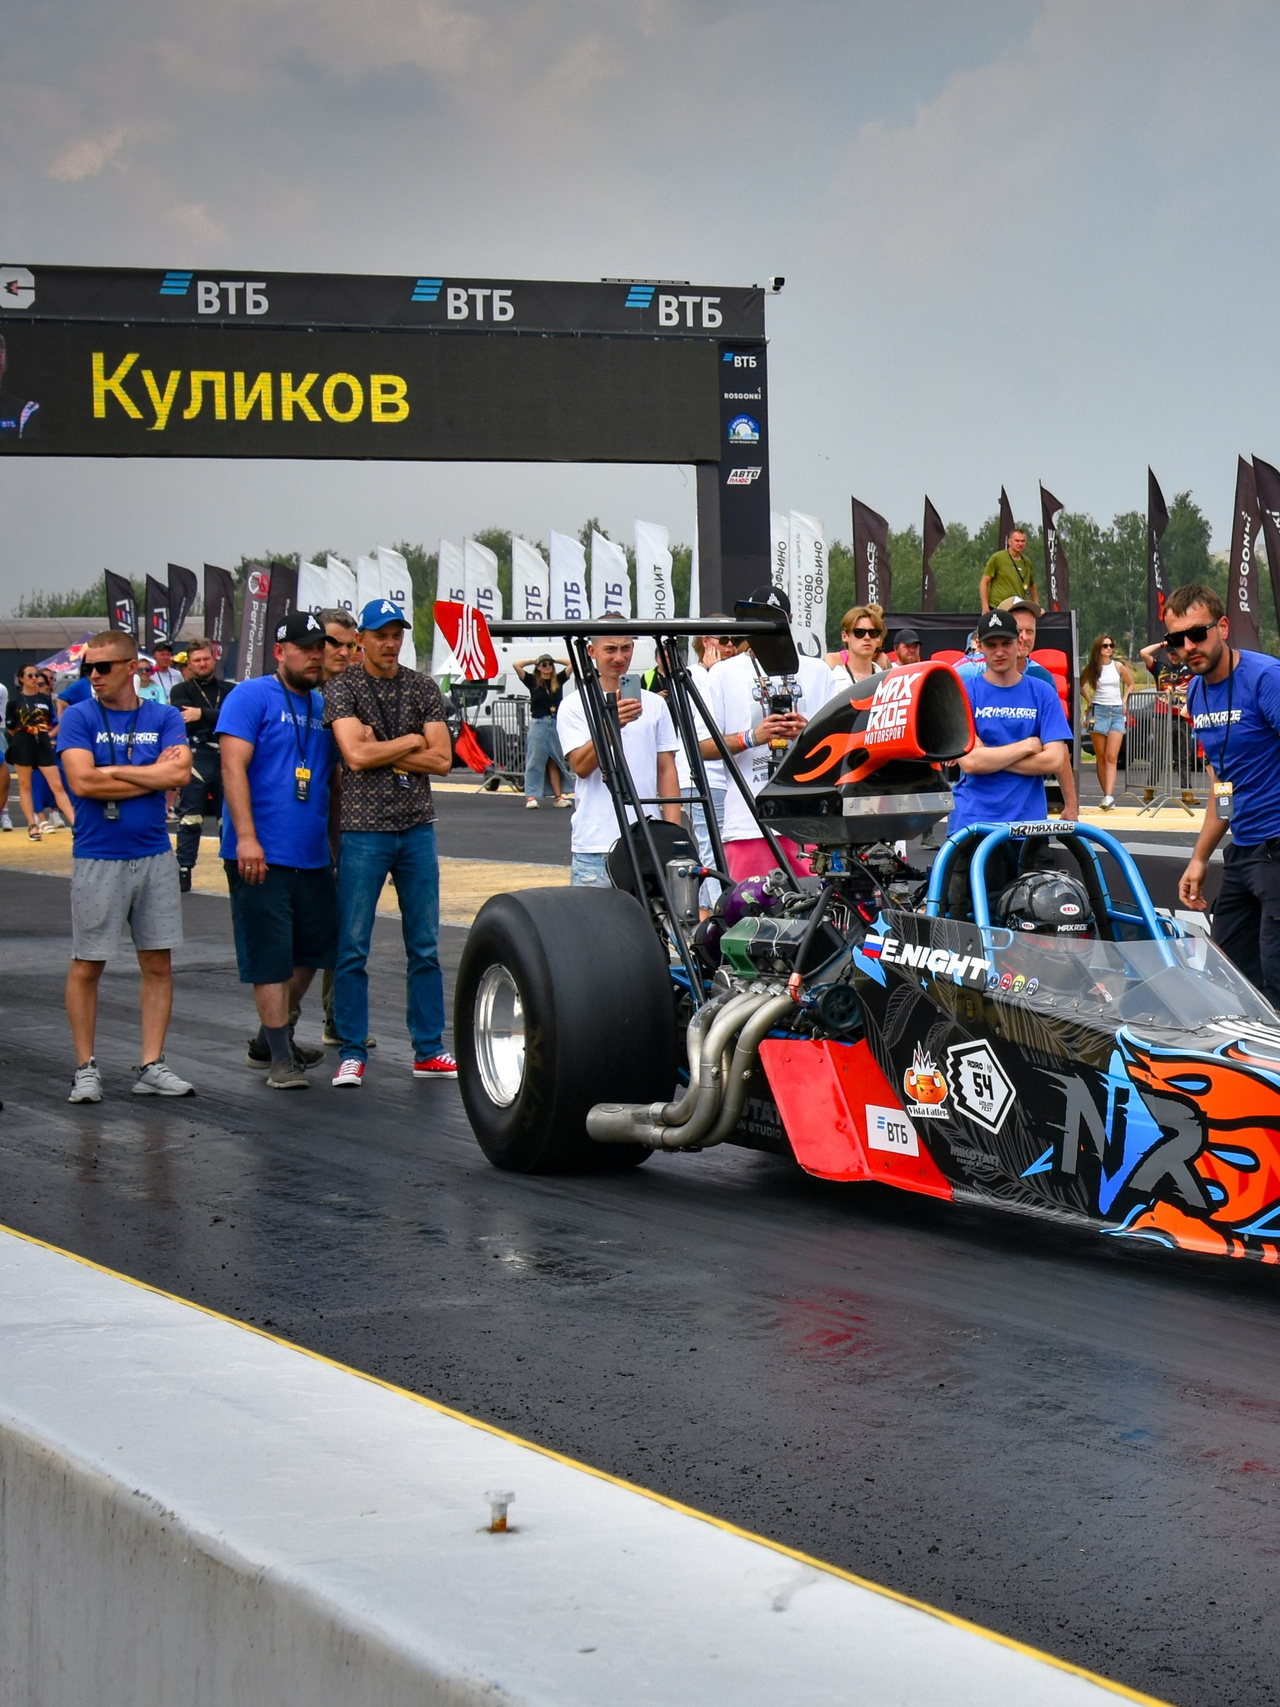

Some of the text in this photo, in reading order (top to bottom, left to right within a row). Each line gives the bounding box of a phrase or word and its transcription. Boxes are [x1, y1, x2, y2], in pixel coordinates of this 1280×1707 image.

[197, 281, 270, 315] ВТБ
[447, 287, 515, 321] ВТБ
[658, 294, 723, 328] ВТБ
[734, 356, 757, 368] ВТБ
[92, 352, 411, 431] Куликов
[731, 470, 759, 478] АВТО
[814, 541, 824, 605] СОФЬИНО
[653, 564, 667, 619] ОНОЛИТ
[804, 574, 814, 628] БЫКОВО
[872, 673, 922, 706] MAX
[864, 726, 907, 746] MOTORSPORT
[879, 937, 991, 981] E.NIGHT
[972, 1071, 995, 1101] 54
[887, 1122, 908, 1145] ВТБ
